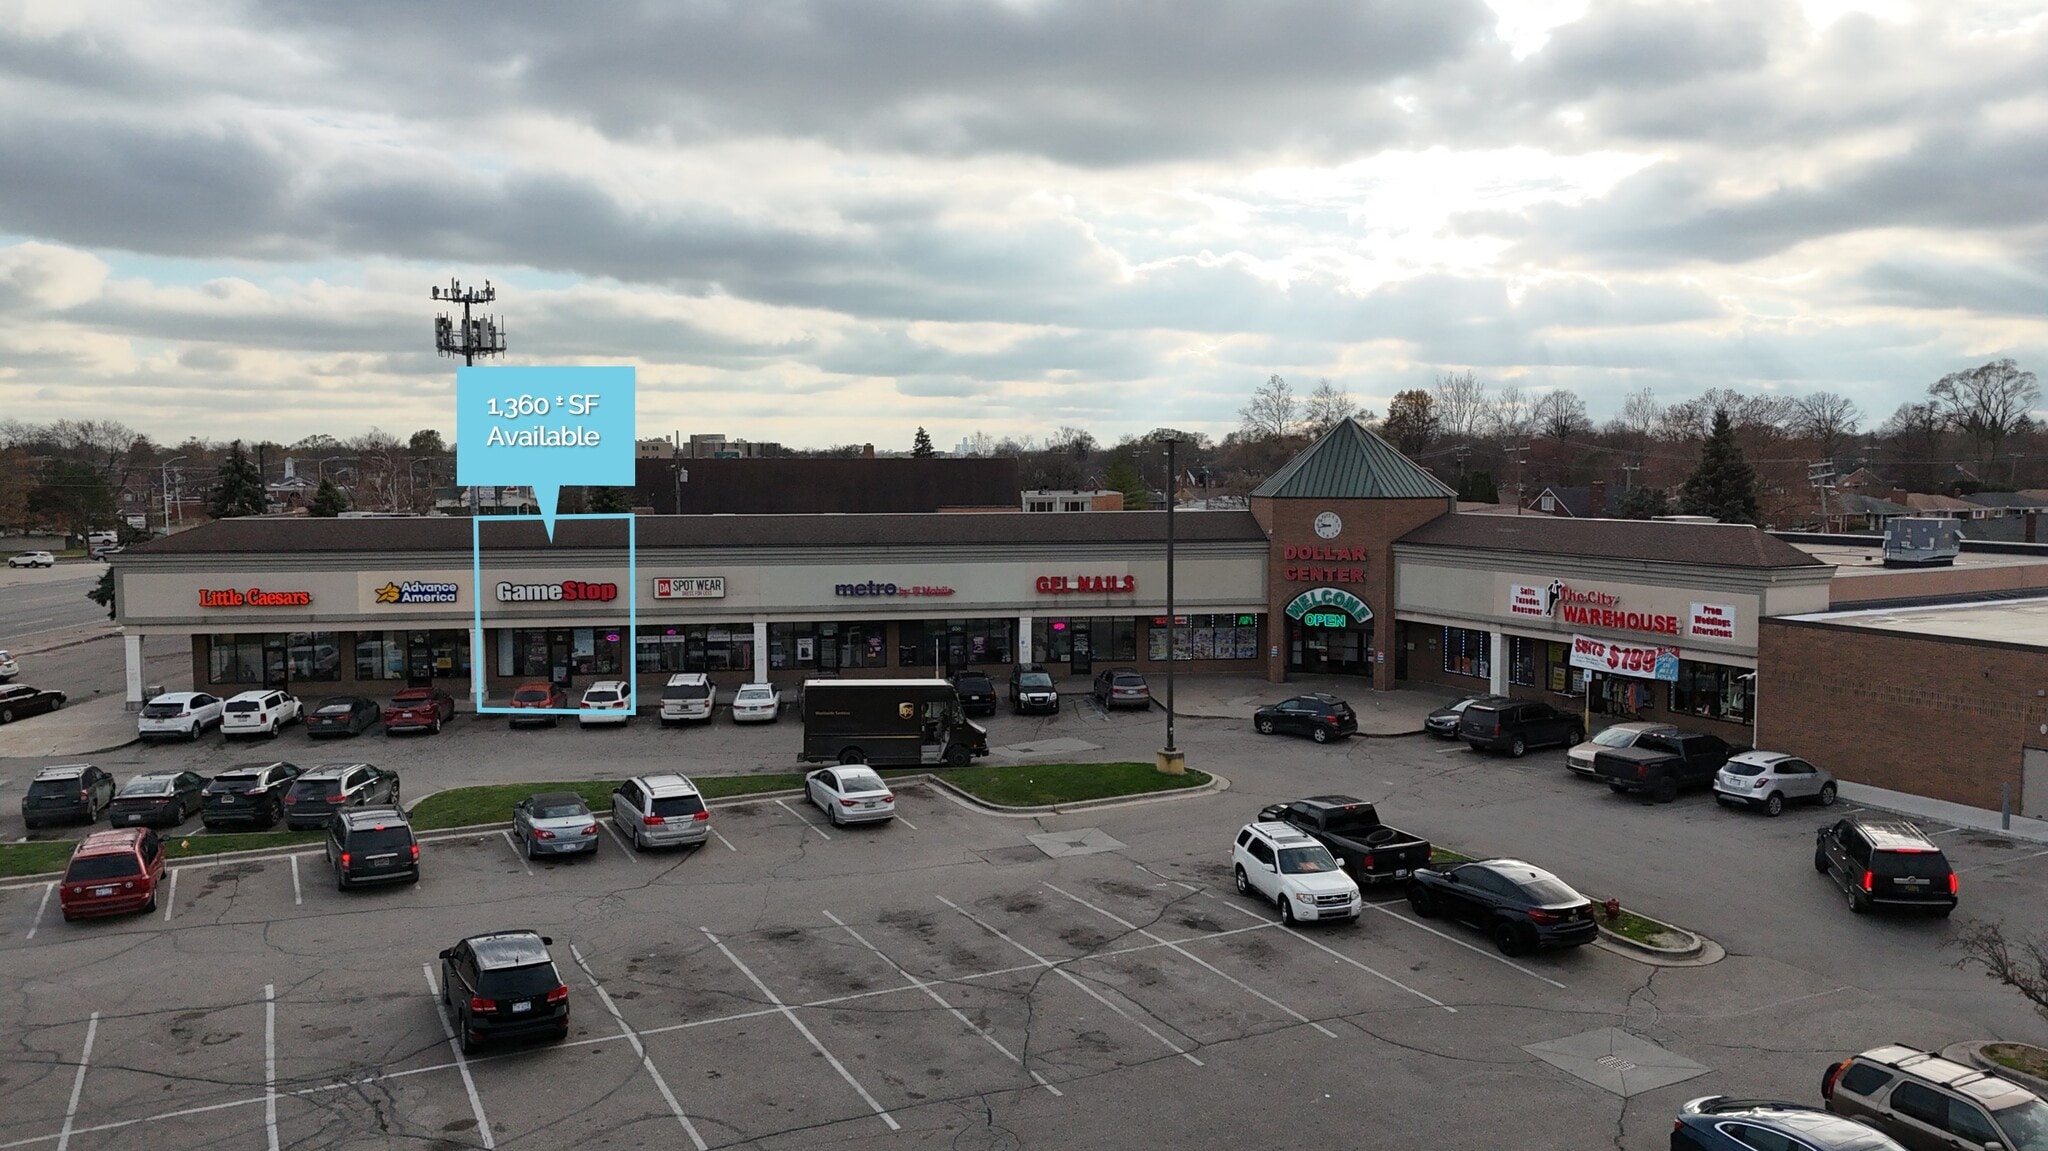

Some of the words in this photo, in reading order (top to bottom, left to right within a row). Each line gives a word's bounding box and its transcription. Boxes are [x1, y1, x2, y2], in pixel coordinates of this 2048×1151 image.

[1283, 545, 1367, 561] DOLLAR
[1283, 565, 1365, 582] CENTER
[401, 581, 458, 593] Advance
[496, 580, 618, 601] GameStop
[659, 583, 670, 593] DA
[672, 580, 695, 591] SPOT
[695, 579, 722, 591] WEAR
[835, 580, 897, 597] metro
[1036, 576, 1073, 595] GEL
[1077, 575, 1136, 594] NAILS
[1520, 587, 1536, 596] Suits
[199, 589, 243, 607] Little
[246, 588, 310, 606] Caesars
[401, 592, 456, 603] America
[1560, 586, 1584, 603] The
[1587, 591, 1616, 607] City
[1287, 590, 1370, 623] WELCOME
[1703, 605, 1723, 616] Prom
[1304, 613, 1347, 628] OPEN
[1563, 605, 1679, 635] WAREHOUSE
[1694, 615, 1732, 628] Weddings
[1691, 625, 1733, 639] Alterations
[1575, 638, 1606, 658] SUITS
[1606, 644, 1657, 674] $199
